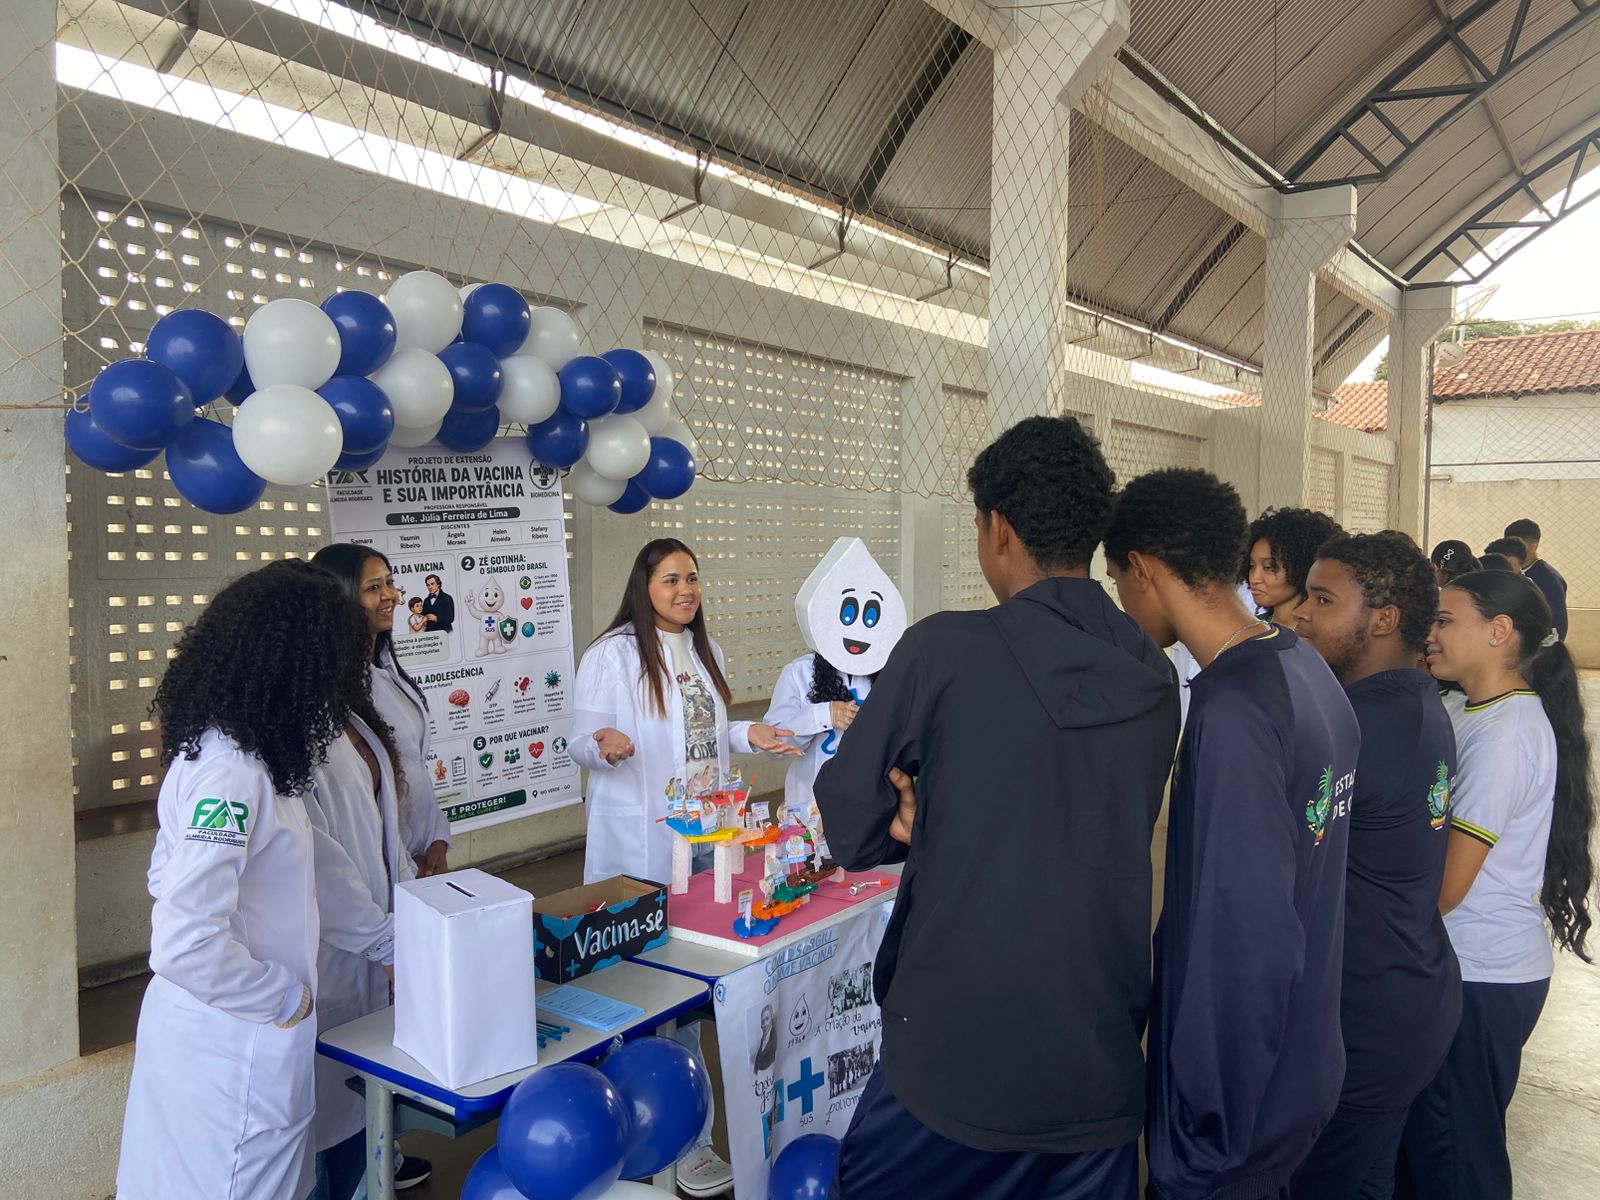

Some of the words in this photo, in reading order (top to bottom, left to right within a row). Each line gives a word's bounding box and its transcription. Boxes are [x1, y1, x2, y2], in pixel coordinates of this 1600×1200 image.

[408, 456, 442, 465] PROJETO
[444, 456, 454, 464] DE
[456, 454, 492, 464] EXTENSÃO
[377, 466, 447, 485] HISTÓRIA
[451, 467, 471, 482] DA
[474, 465, 523, 481] VACINA
[383, 488, 393, 503] E
[397, 487, 428, 502] SUA
[432, 481, 525, 501] IMPORTÂNCIA
[530, 491, 560, 499] BIOMEDICINA
[401, 514, 418, 523] Me.
[420, 513, 440, 522] Júlia
[442, 511, 475, 521] Ferreira
[477, 510, 488, 519] de
[489, 509, 508, 518] Lima
[447, 530, 465, 539] Ângela
[464, 558, 472, 568] 2
[478, 555, 489, 566] ZÉ
[490, 553, 527, 565] GOTINHA:
[401, 564, 412, 574] DA
[414, 561, 445, 572] VACINA
[479, 567, 485, 575] O
[486, 564, 515, 575] SÍMBOLO
[517, 563, 525, 571] DO
[526, 562, 548, 571] BRASIL
[424, 666, 484, 684] ADOLESCÊNCIA
[489, 735, 503, 745] POR
[504, 732, 517, 742] QUE
[518, 725, 549, 739] VACINAR?
[1334, 768, 1356, 797] ESTA
[451, 807, 457, 816] É
[459, 796, 506, 813] PROTEGER!
[191, 797, 249, 833] FAR
[198, 830, 237, 839] FACULDADE
[213, 836, 246, 845] RODRIGUES
[574, 908, 664, 960] Vacina-se
[799, 1113, 814, 1128] SUS
